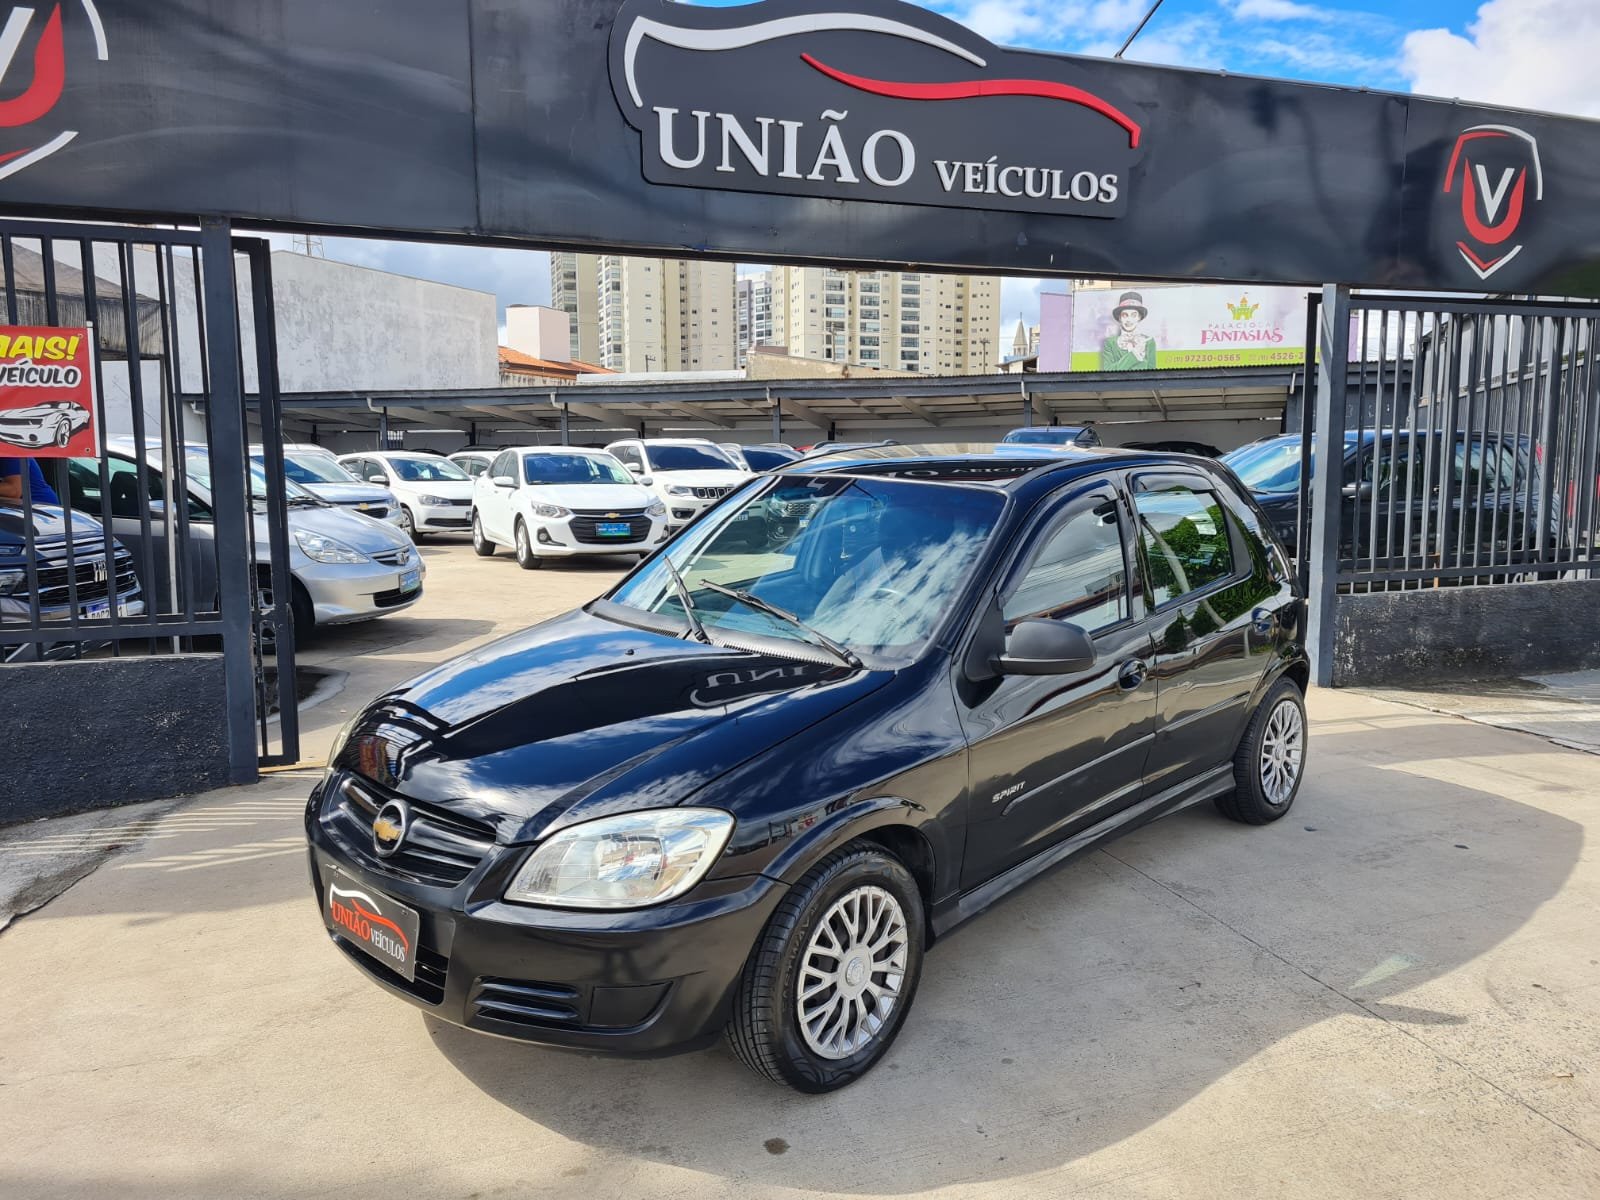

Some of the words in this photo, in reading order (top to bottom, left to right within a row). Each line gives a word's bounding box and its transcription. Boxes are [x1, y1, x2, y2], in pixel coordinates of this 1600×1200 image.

[652, 106, 915, 187] UNIÃO
[933, 155, 1118, 203] VEÍCULOS
[1200, 328, 1284, 344] FANTASIAS
[992, 781, 1026, 803] SPIRIT
[332, 900, 371, 940] UNIÃO
[371, 927, 405, 962] VEÍCULOS
